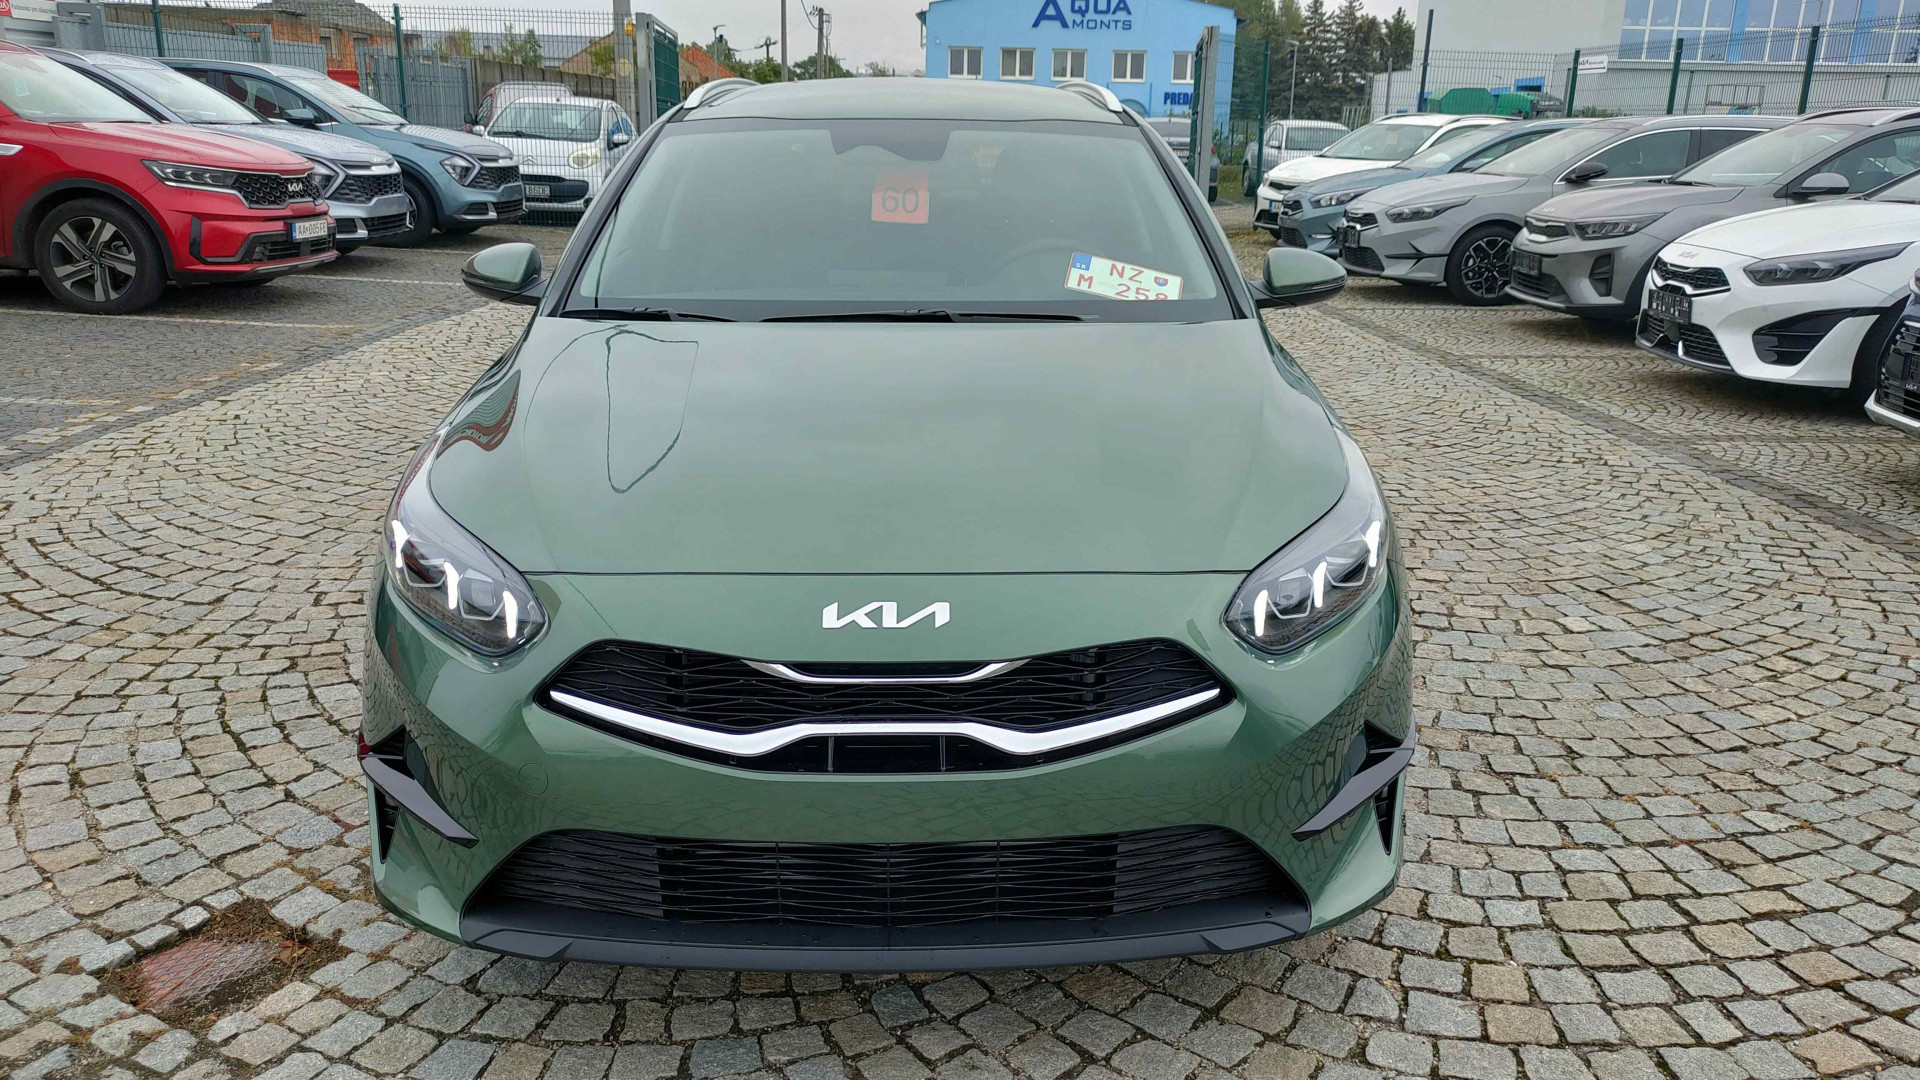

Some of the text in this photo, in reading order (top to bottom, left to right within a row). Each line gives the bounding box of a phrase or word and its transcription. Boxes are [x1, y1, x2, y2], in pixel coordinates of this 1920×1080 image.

[1032, 0, 1132, 29] AQUA
[1072, 19, 1132, 31] MONTS
[881, 186, 920, 214] 60
[1077, 273, 1094, 289] M
[1109, 263, 1144, 283] NZ
[822, 601, 950, 629] KIA
